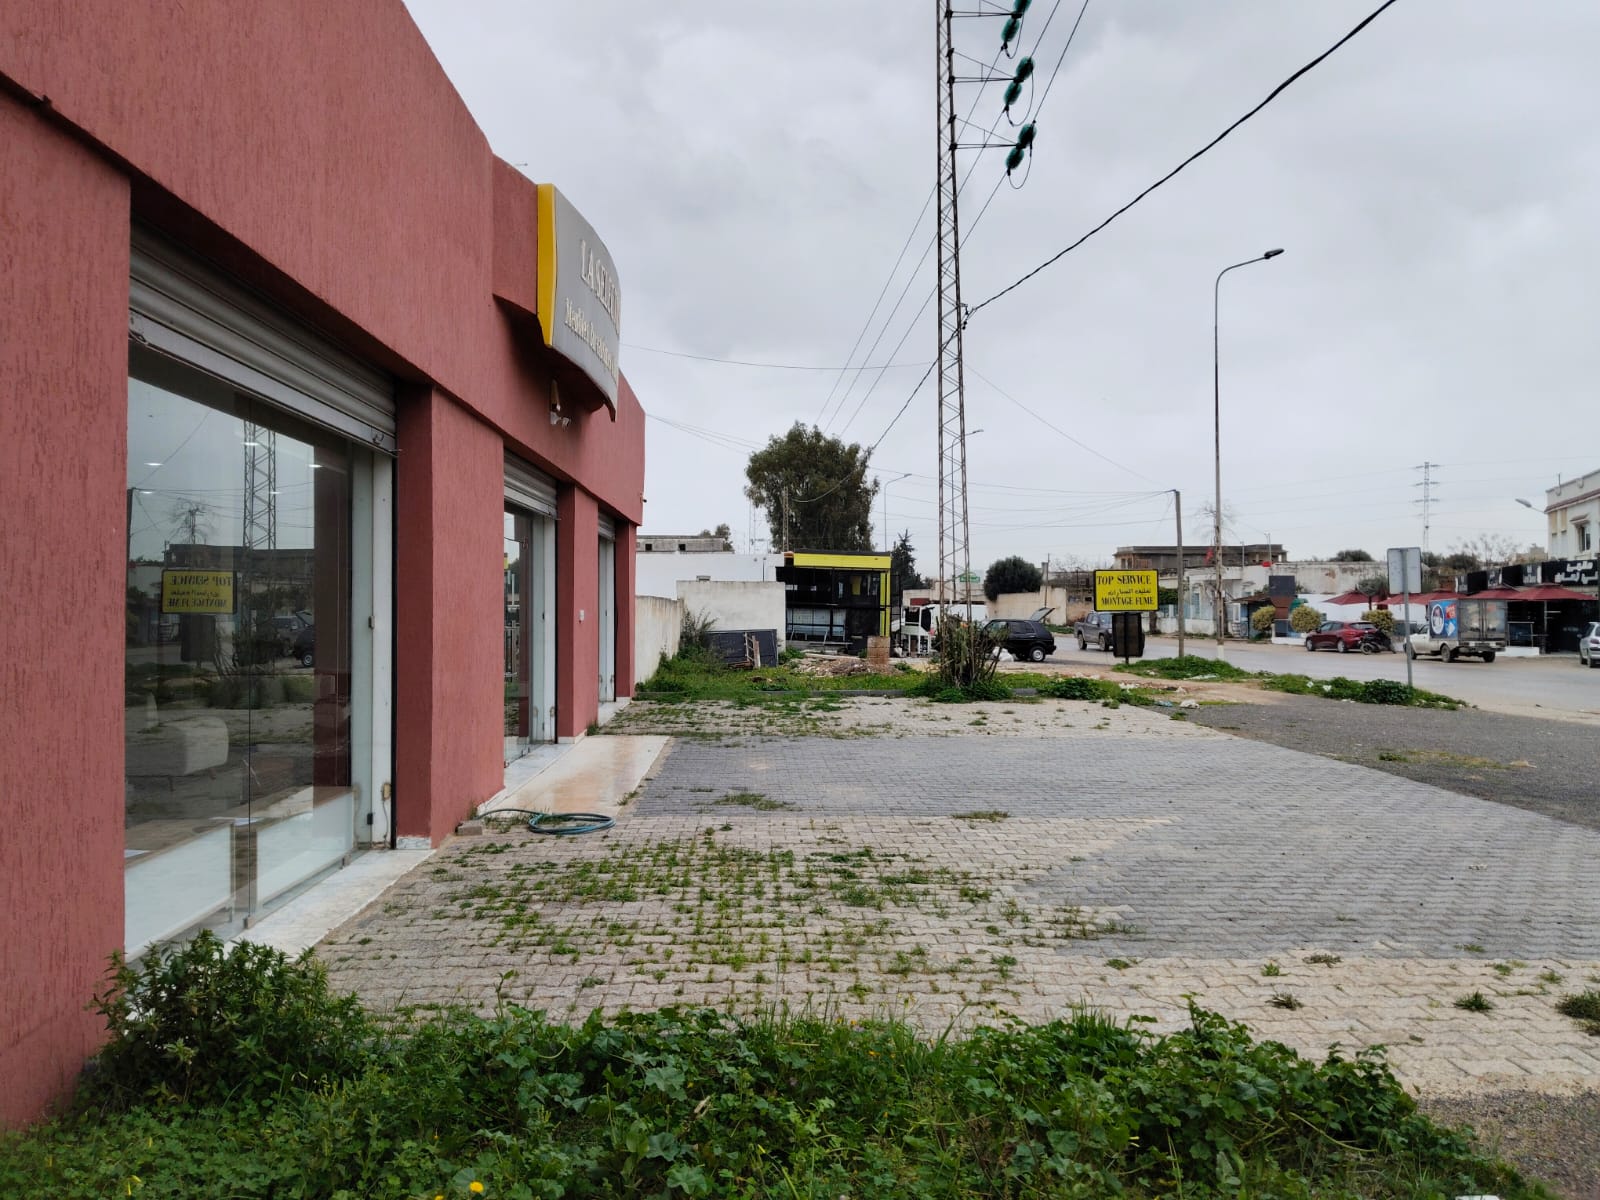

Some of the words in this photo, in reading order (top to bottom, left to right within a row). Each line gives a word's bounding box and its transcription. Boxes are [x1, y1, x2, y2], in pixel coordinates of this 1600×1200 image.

[1097, 576, 1114, 585] TOP
[1117, 575, 1151, 585] SERVICE
[1102, 597, 1133, 605] MONTAGE
